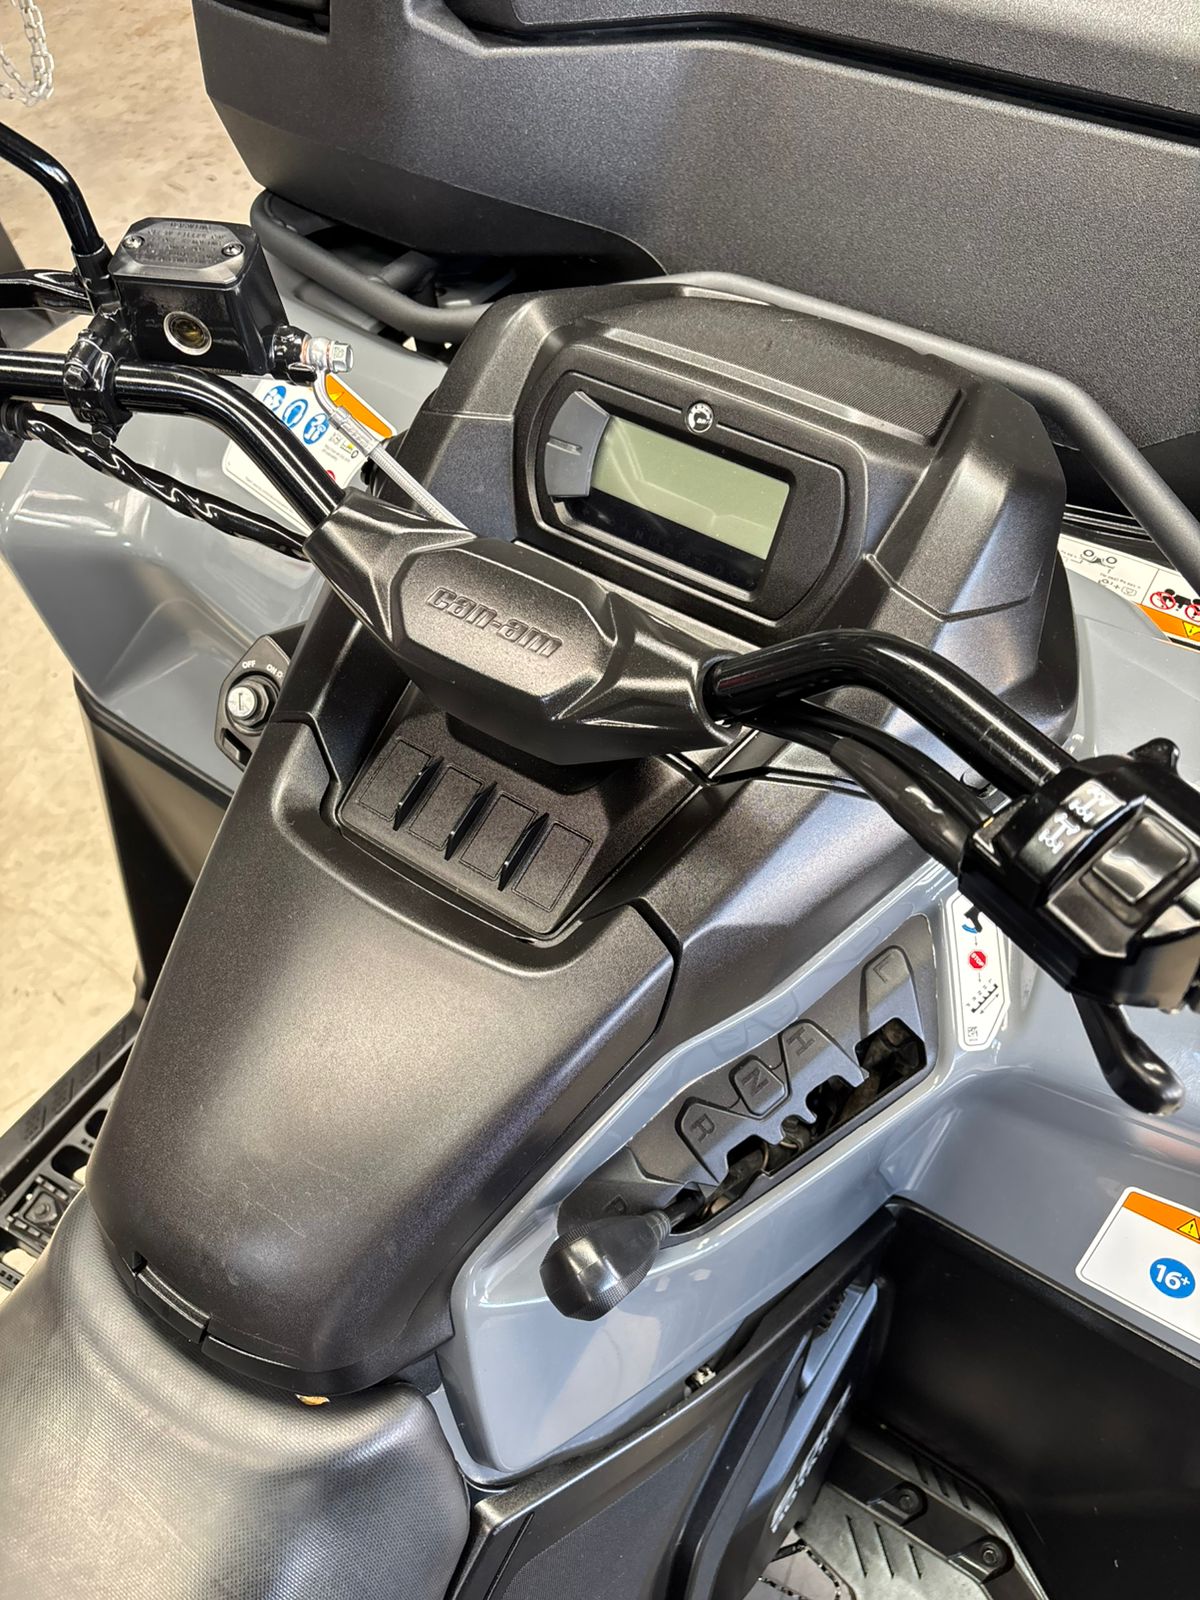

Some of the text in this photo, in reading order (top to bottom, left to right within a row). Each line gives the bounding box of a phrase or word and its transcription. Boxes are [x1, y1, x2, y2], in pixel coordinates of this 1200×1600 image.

[426, 586, 563, 658] can-am
[242, 660, 256, 669] OFF
[266, 664, 277, 675] ON
[872, 953, 892, 983] L
[969, 952, 985, 967] STOP
[789, 1026, 815, 1055] H
[741, 1070, 769, 1095] N
[691, 1113, 716, 1141] R
[1156, 1263, 1191, 1290] 16+
